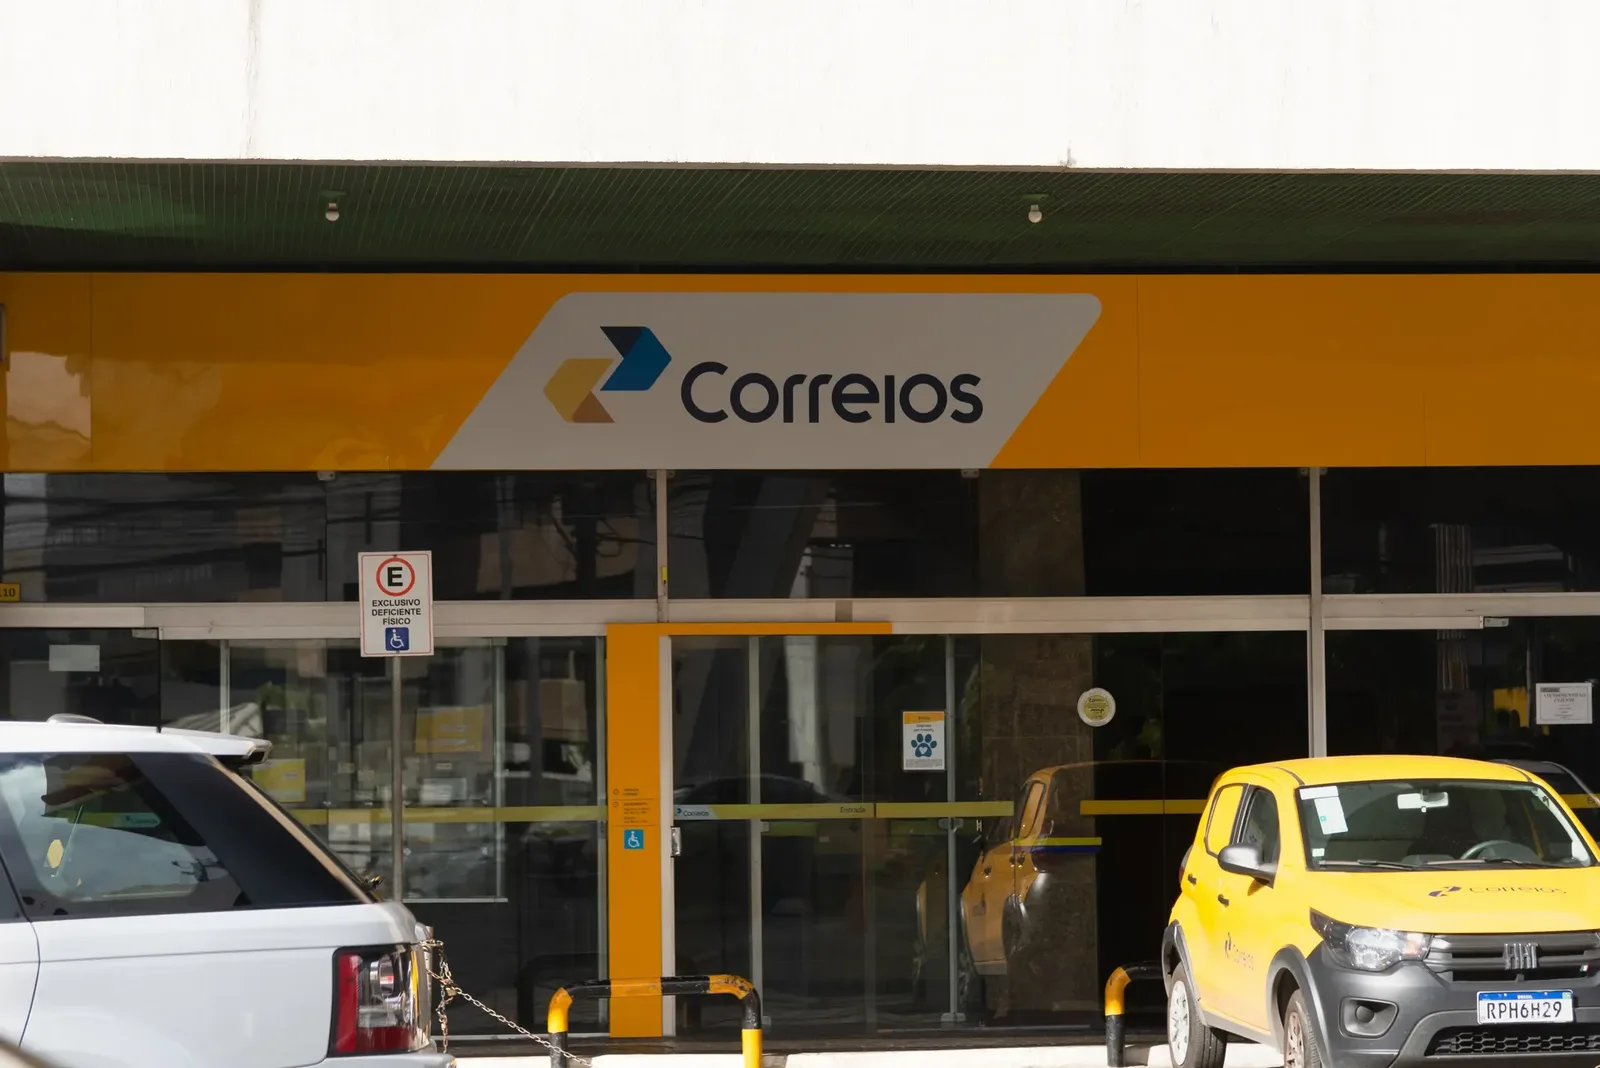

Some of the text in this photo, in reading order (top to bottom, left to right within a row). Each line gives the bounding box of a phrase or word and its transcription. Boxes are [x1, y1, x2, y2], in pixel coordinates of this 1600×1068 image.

[681, 361, 984, 424] Correios
[387, 566, 404, 587] E
[372, 599, 421, 608] EXCLUSIVO
[371, 608, 422, 616] DEFICIENTE
[382, 617, 411, 625] FÍSICO
[1486, 1001, 1563, 1019] RPH6H29
